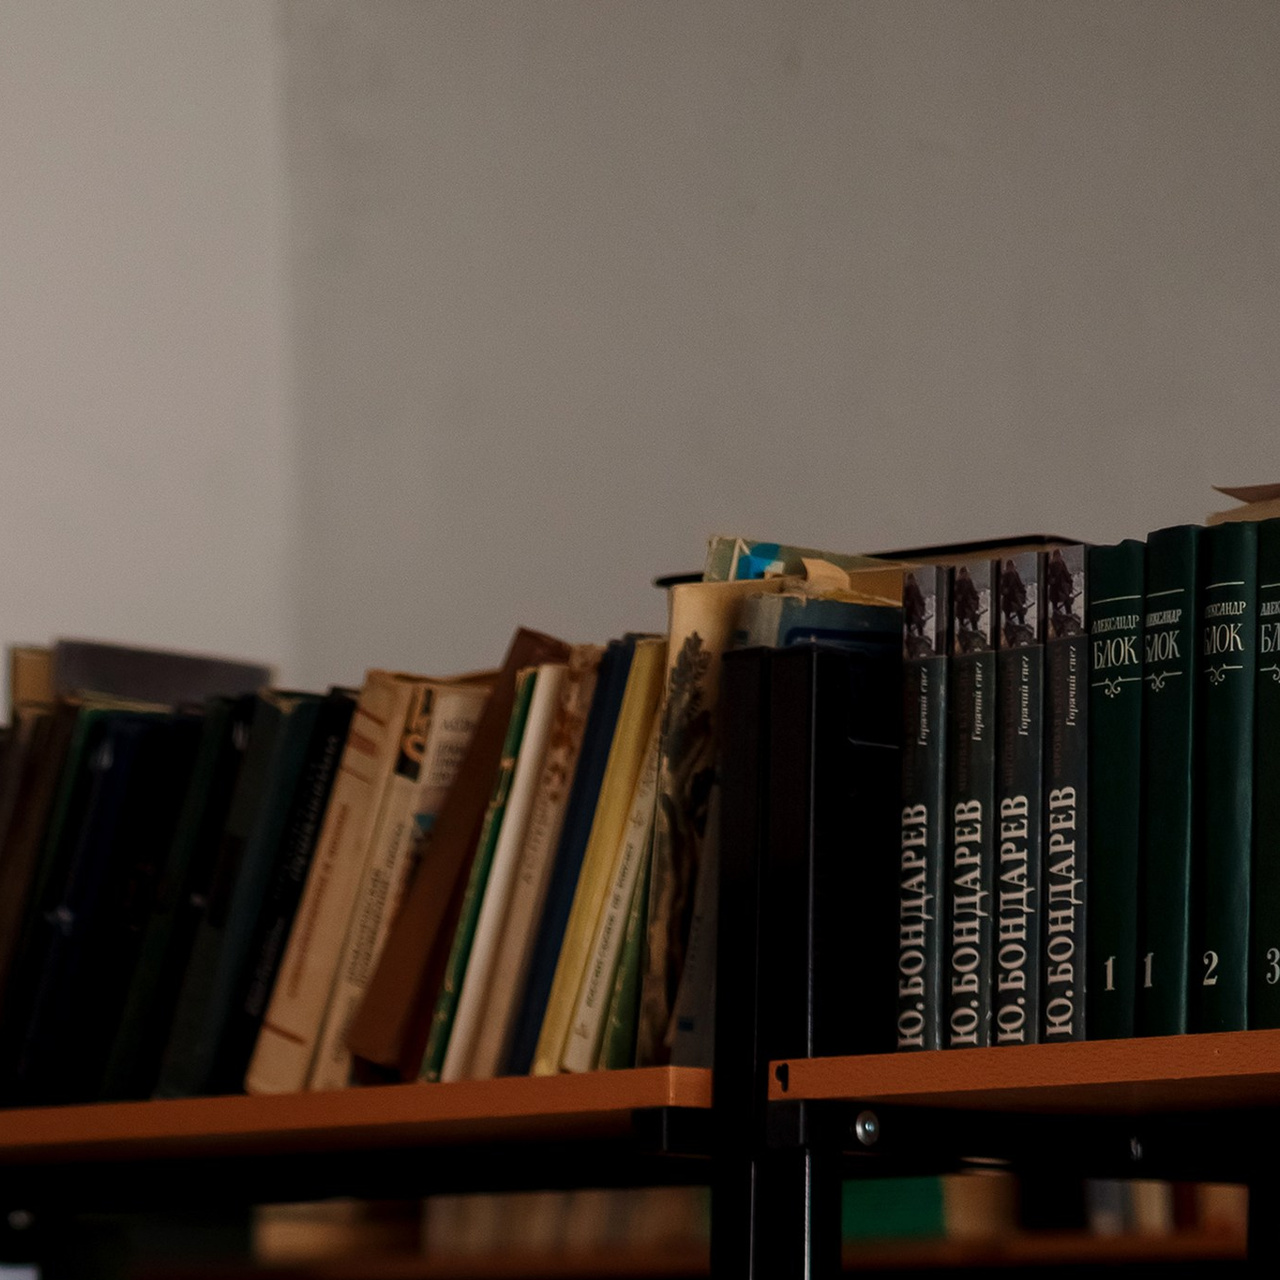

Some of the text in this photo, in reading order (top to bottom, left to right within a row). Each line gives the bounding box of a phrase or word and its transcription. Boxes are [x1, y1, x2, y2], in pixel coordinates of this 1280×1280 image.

[1093, 636, 1139, 669] БЛОК
[897, 804, 934, 1049] Ю. БОНДАРЕВ
[949, 799, 989, 1046] Ю. БОНДАРЕВ
[997, 795, 1035, 1044] Ю. БОНДАРЕВ
[1046, 786, 1083, 1035] Ю. БОНДАРЕВ
[1104, 956, 1116, 991] 1
[1144, 952, 1154, 988] 1
[1203, 951, 1219, 986] 2
[1266, 948, 1280, 985] 3
